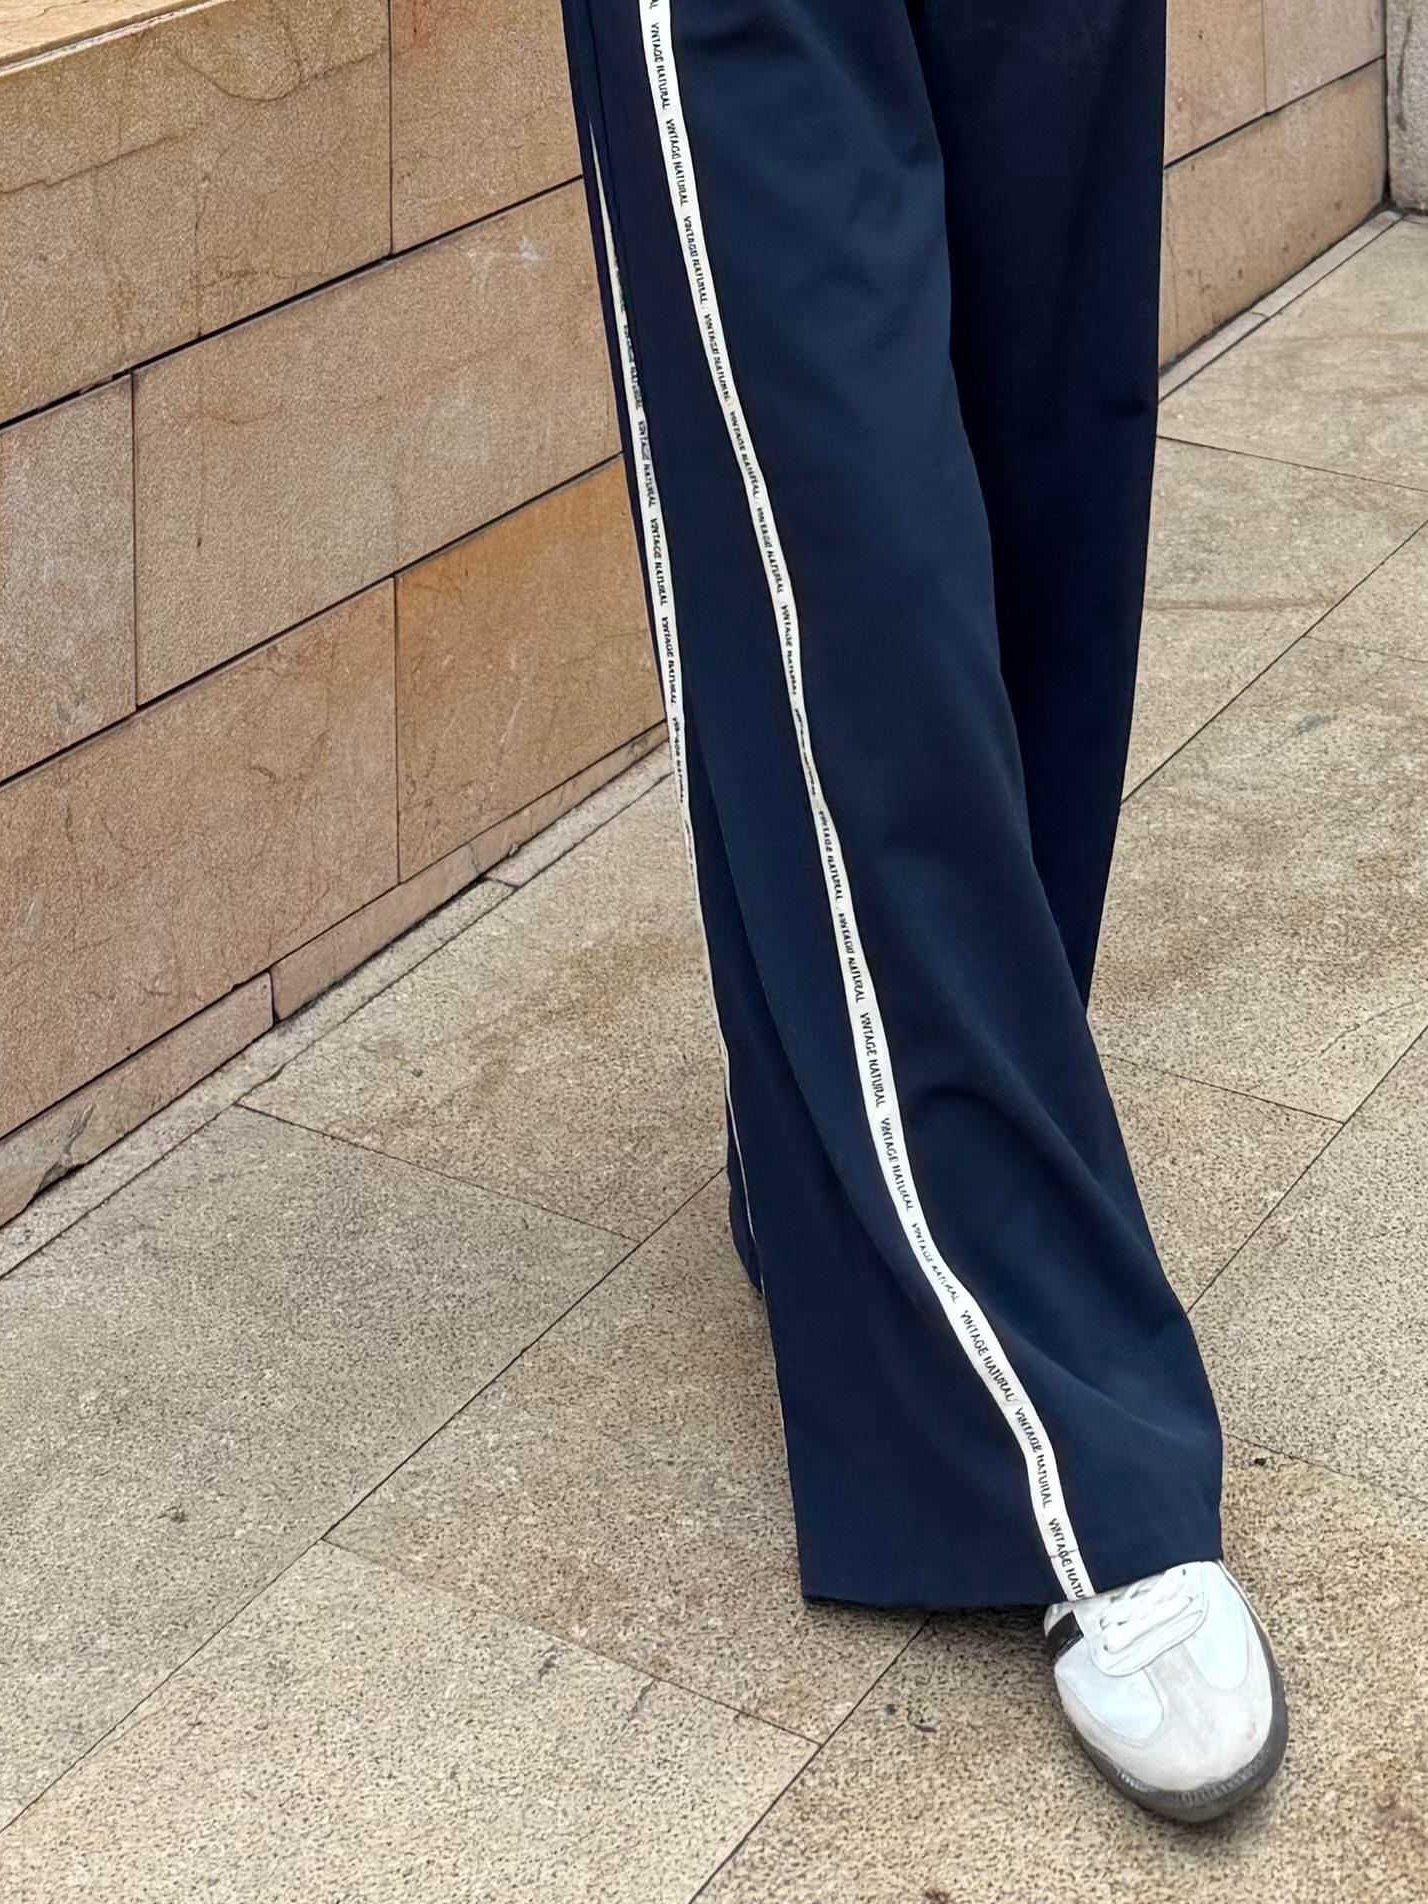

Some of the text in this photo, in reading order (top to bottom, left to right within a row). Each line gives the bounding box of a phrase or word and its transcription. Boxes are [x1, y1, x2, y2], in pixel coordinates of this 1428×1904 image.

[651, 23, 670, 110] VINTAGE NATURAL
[666, 119, 688, 206] VINTAGE NATURAL
[692, 259, 707, 305] NATURAL
[860, 1012, 885, 1107] VINTAGE NATURAL
[881, 1118, 913, 1210] VINTAGE NATURAL
[961, 1310, 1015, 1402] VINTAGE NATURAL
[1015, 1407, 1052, 1508] VINTAGE NATURAL
[1049, 1518, 1072, 1568] VINTAGE
